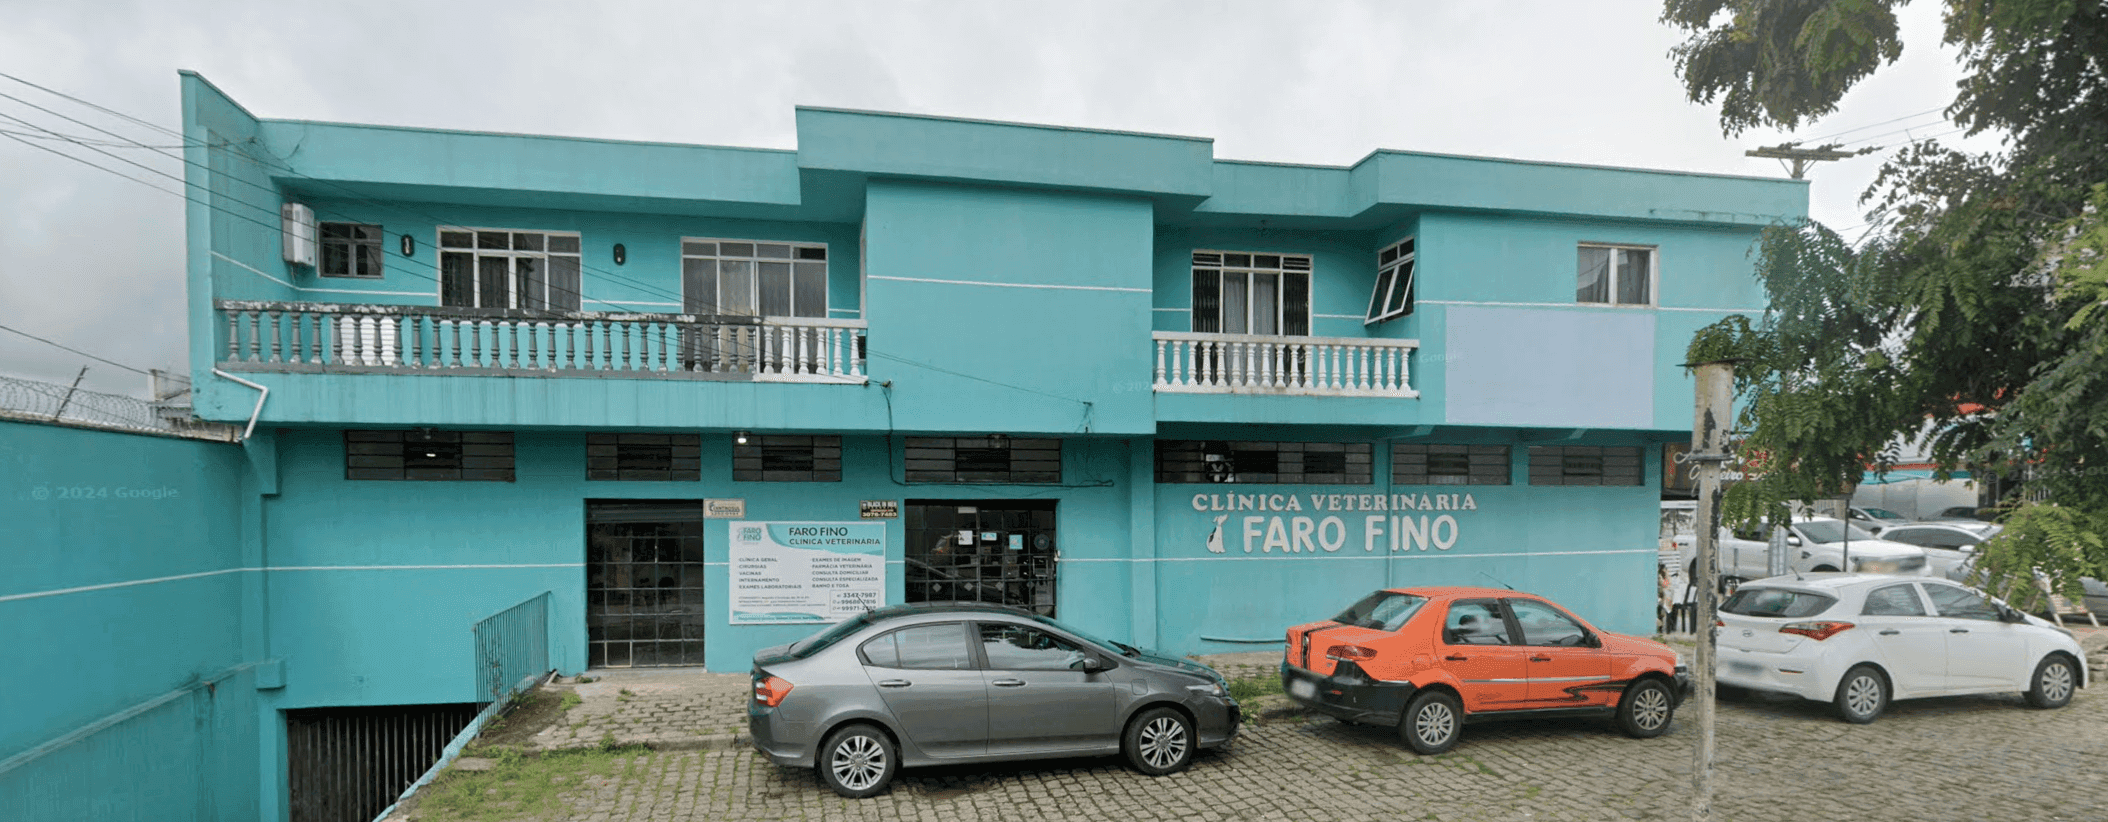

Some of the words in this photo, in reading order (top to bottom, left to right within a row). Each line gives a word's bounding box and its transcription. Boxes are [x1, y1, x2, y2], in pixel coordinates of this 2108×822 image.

[1191, 490, 1303, 512] CLÍNICA
[1310, 491, 1478, 512] VETERINÁRIA
[743, 533, 762, 541] FINO
[788, 526, 818, 536] FARO
[819, 526, 848, 536] FINO
[1243, 515, 1347, 553] FARO
[1364, 514, 1459, 552] FINO
